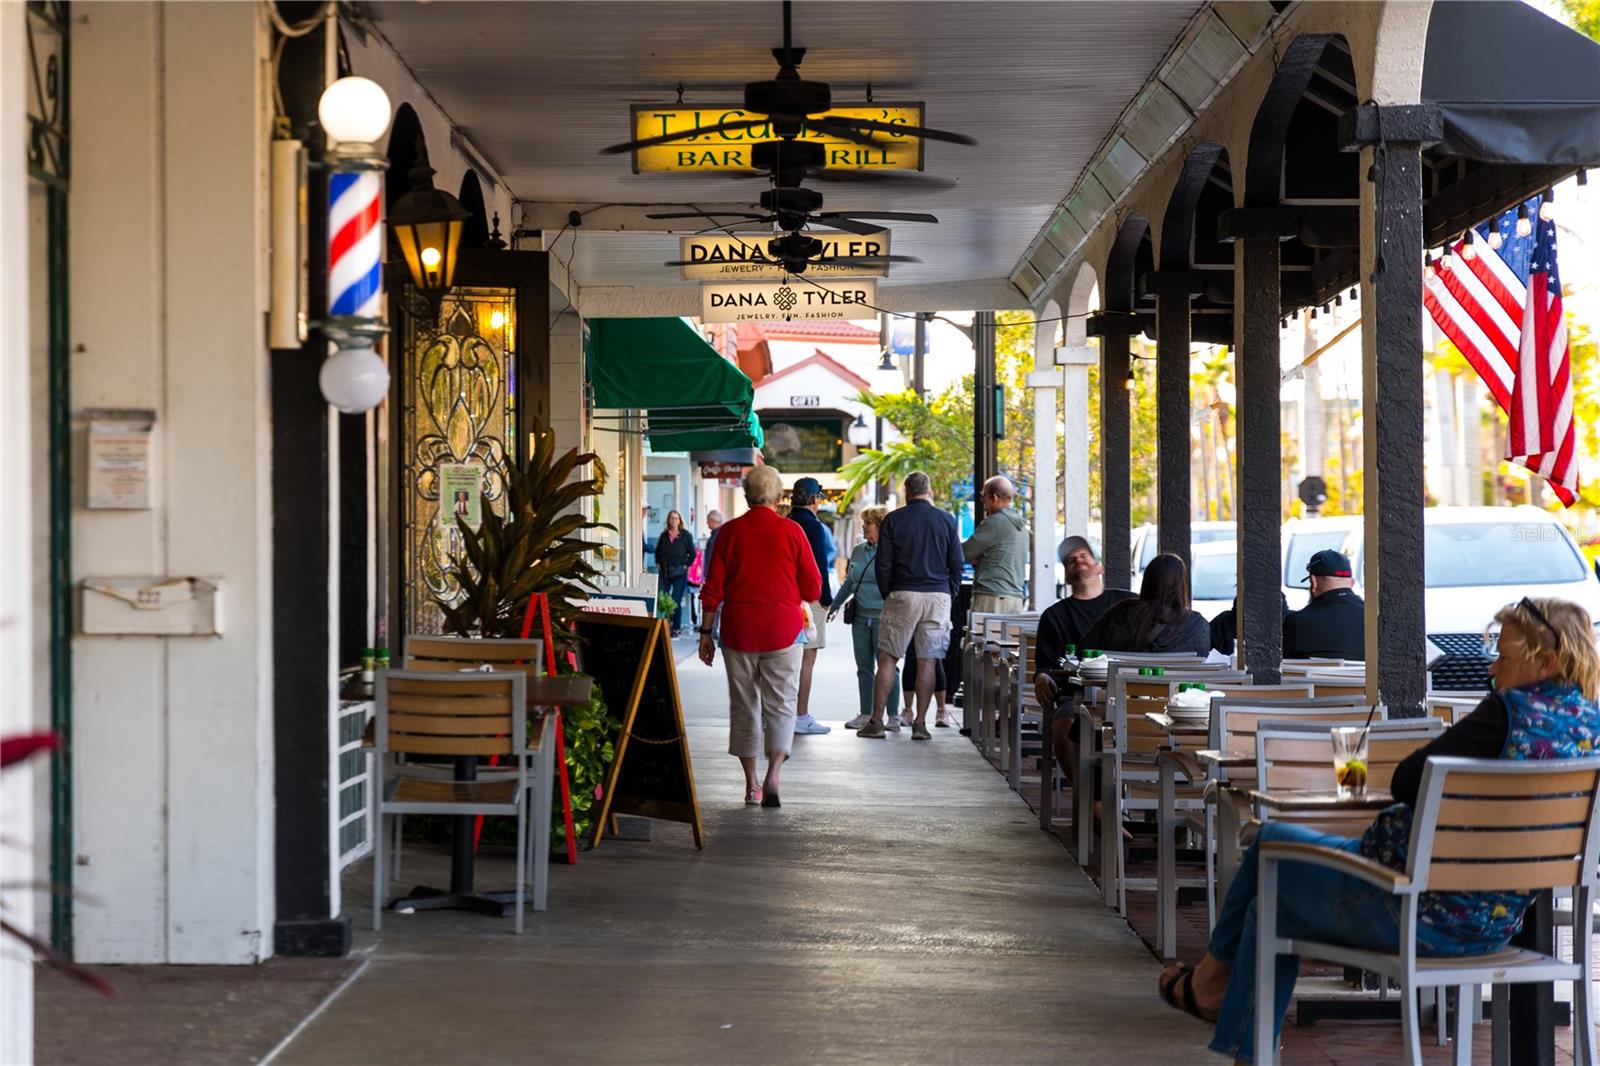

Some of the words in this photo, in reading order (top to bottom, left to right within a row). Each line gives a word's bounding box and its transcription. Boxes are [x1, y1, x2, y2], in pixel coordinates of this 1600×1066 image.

[678, 151, 744, 166] BAR
[826, 150, 896, 165] RILL
[691, 243, 767, 262] DANA
[820, 241, 881, 259] YLER
[720, 264, 764, 273] JEWELRY
[711, 292, 767, 307] DANA
[803, 290, 867, 305] TYLER
